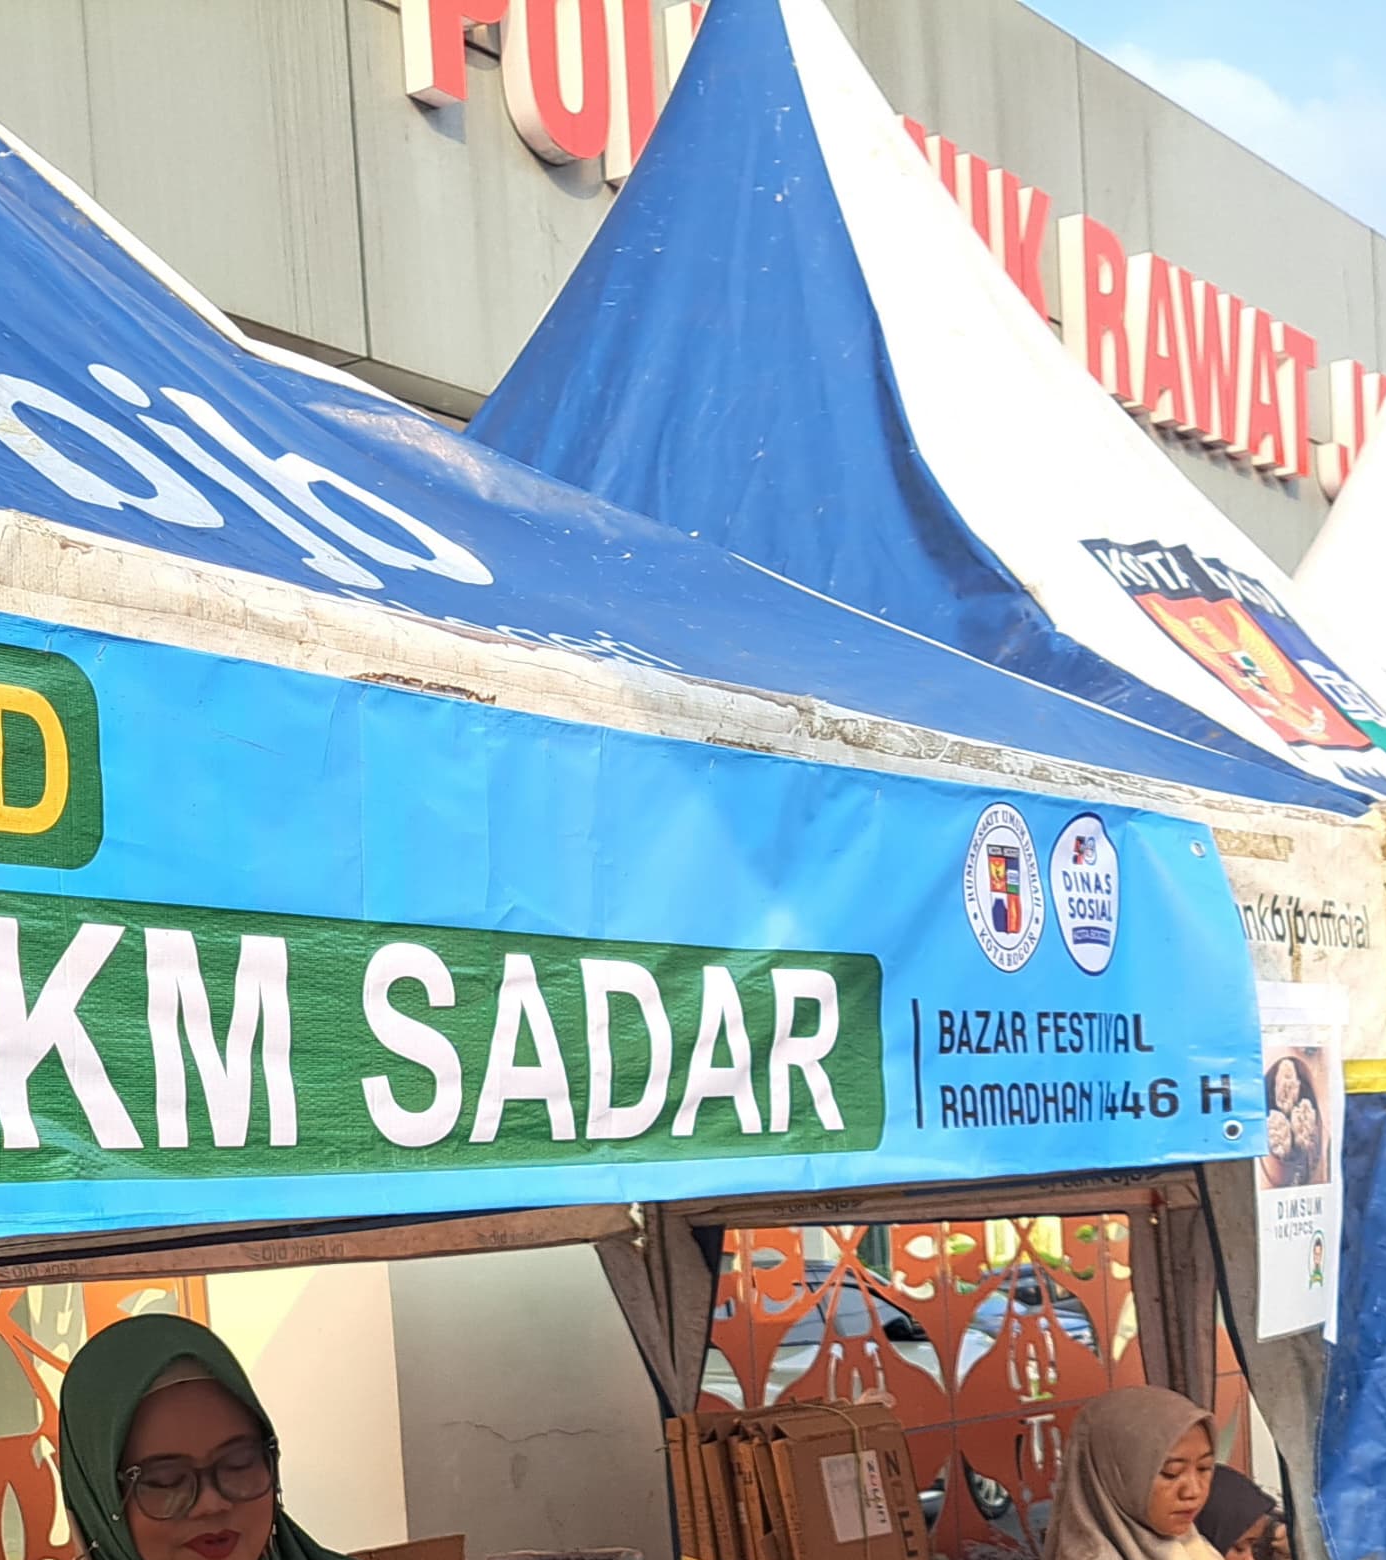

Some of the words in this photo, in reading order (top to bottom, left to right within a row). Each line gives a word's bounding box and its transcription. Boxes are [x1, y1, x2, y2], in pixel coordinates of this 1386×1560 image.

[1059, 213, 1317, 480] RAWAT
[1061, 870, 1112, 895] DINAS
[1068, 897, 1113, 922] SOSIAL
[362, 942, 844, 1148] SADAR
[938, 1010, 1028, 1054] BAZAR
[1037, 1011, 1154, 1054] FESTIVAL
[940, 1081, 1093, 1128] RAMADHAN
[1098, 1078, 1180, 1121] 1446
[1200, 1074, 1233, 1114] H
[1277, 1197, 1322, 1219] DIMSUM
